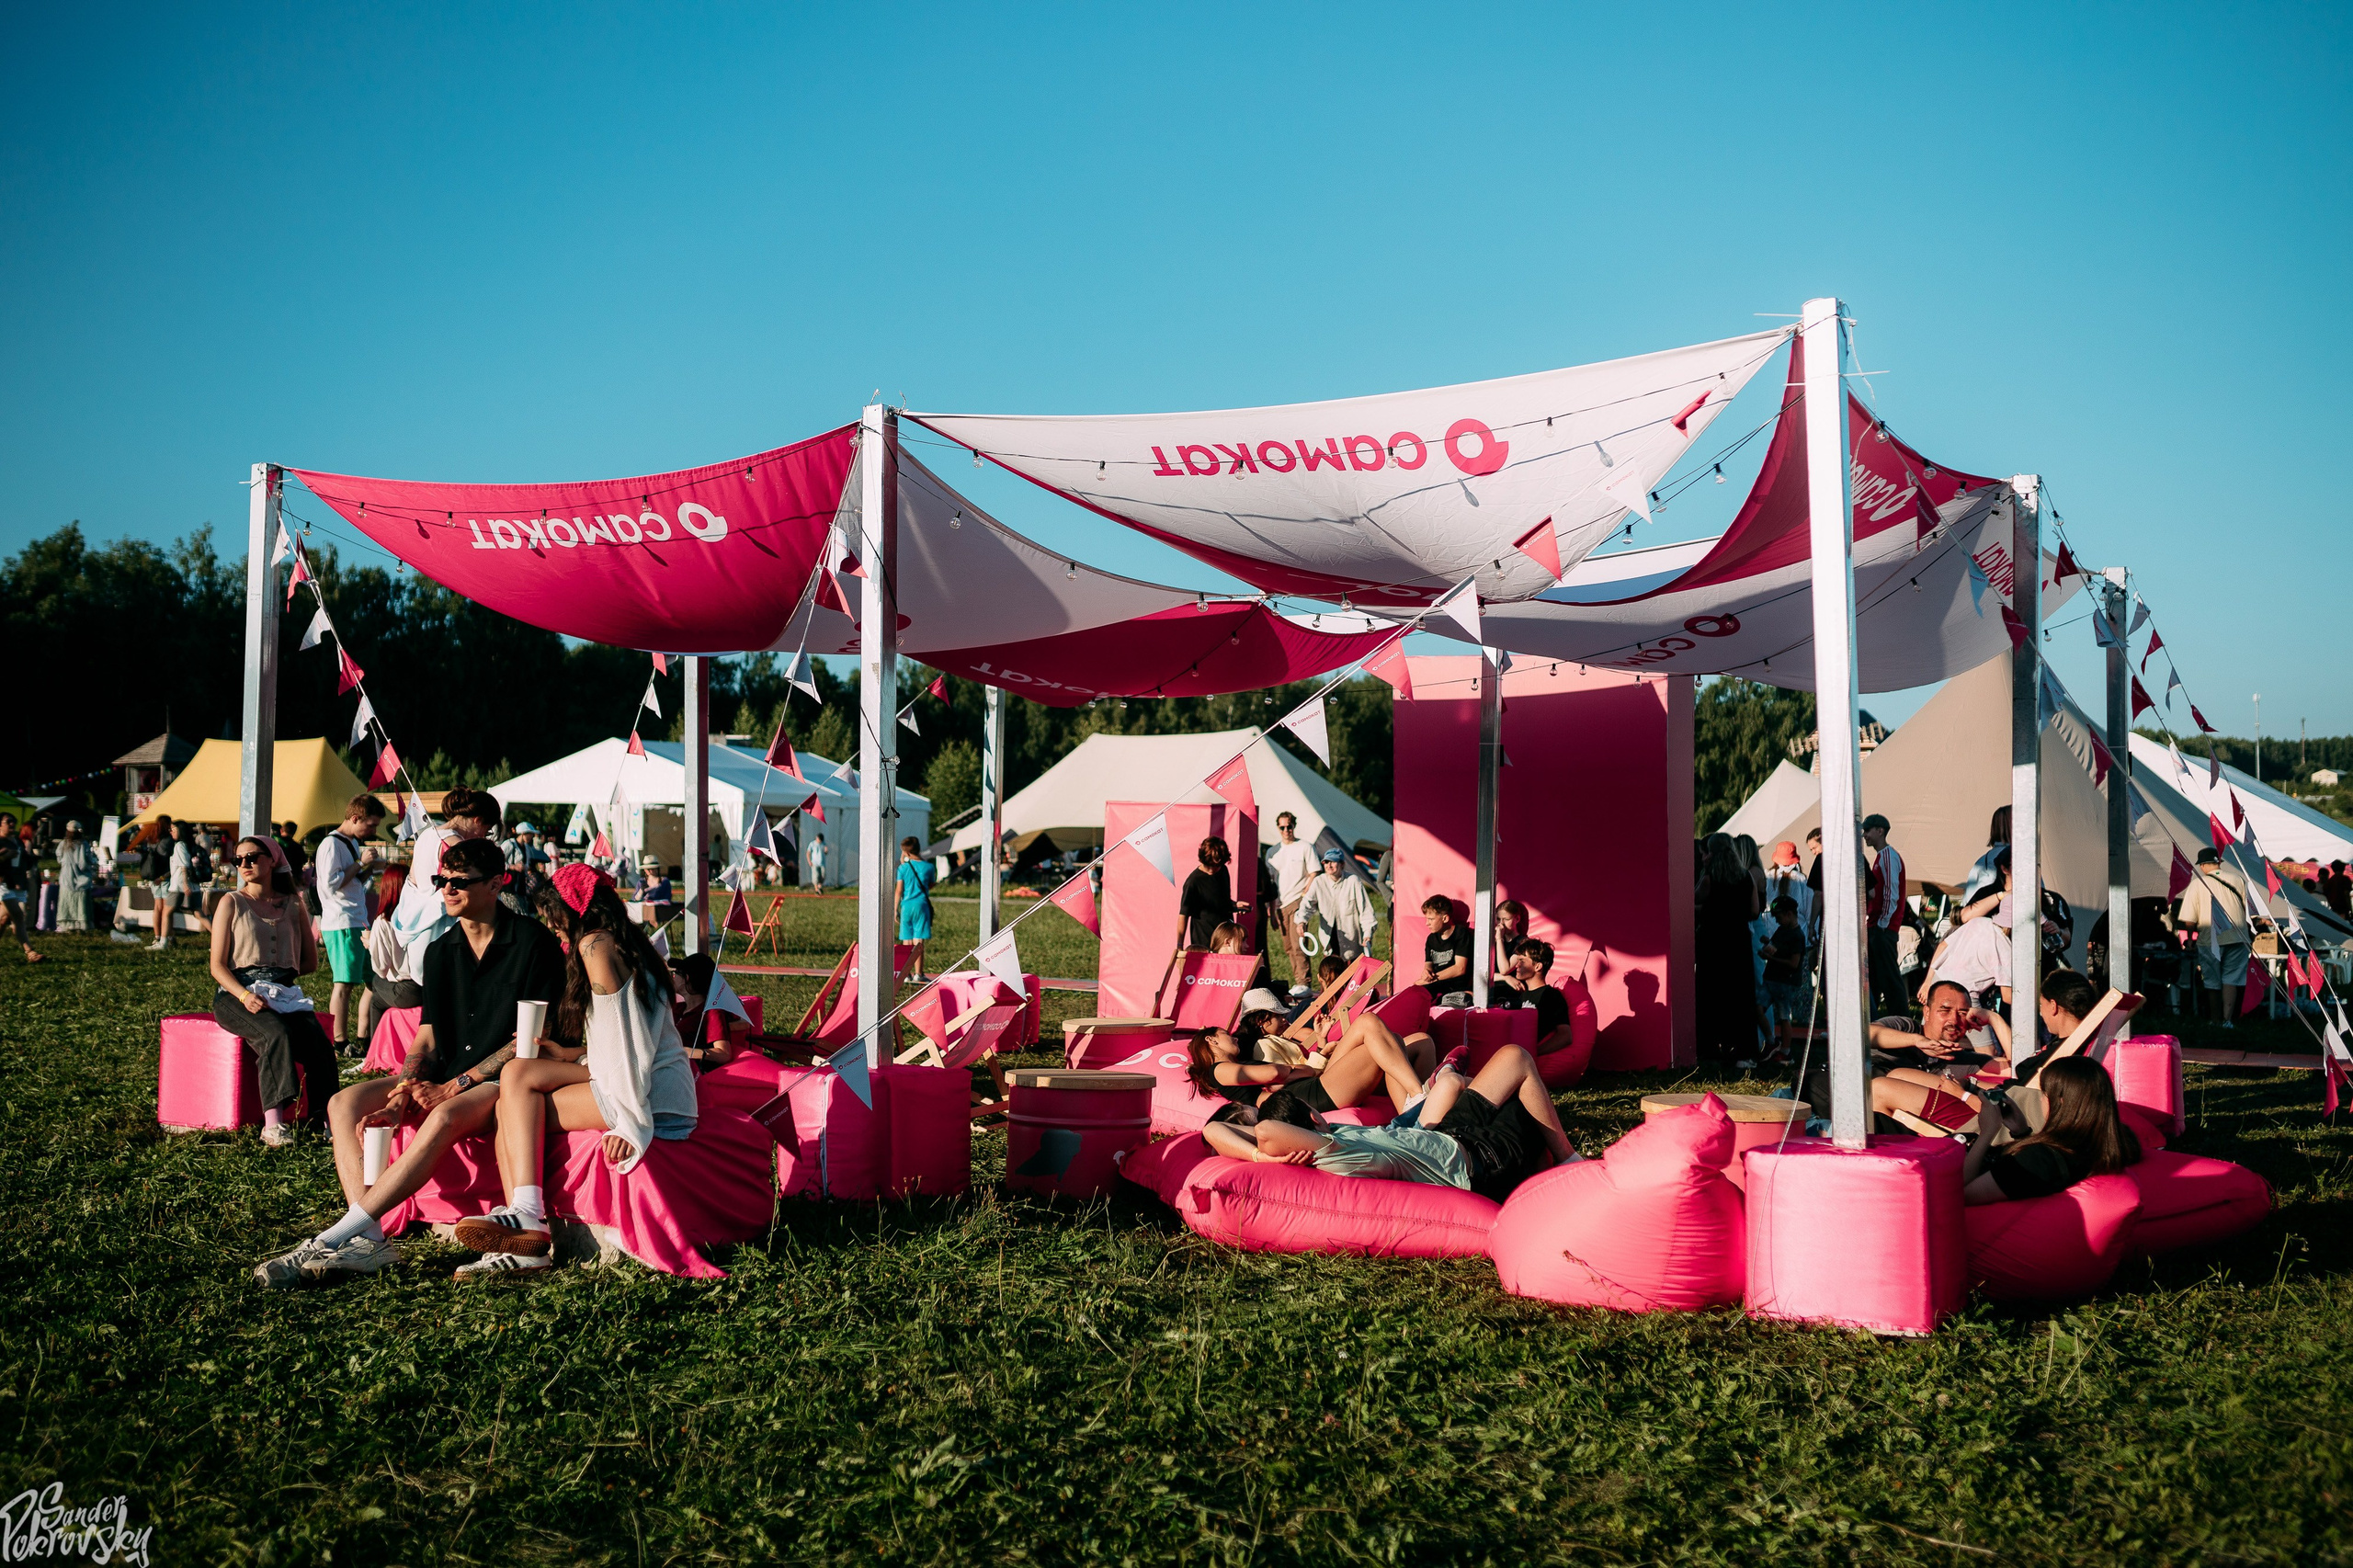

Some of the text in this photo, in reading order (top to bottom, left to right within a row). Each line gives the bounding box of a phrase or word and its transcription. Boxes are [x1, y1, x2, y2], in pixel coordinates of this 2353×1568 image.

[1151, 431, 1427, 477] самокат
[468, 511, 672, 550] самокат
[1529, 528, 1552, 545] самокат
[1449, 587, 1472, 603] самокат
[1378, 652, 1401, 667] самокат
[1297, 710, 1322, 725] самокат
[1222, 769, 1245, 787] самокат
[1141, 827, 1165, 843] самокат
[1065, 886, 1088, 902] самокат
[991, 944, 1013, 960] самокат
[1198, 977, 1247, 988] самокат
[915, 998, 938, 1014] самокат
[844, 1053, 864, 1068] самокат
[769, 1107, 789, 1123] самокат
